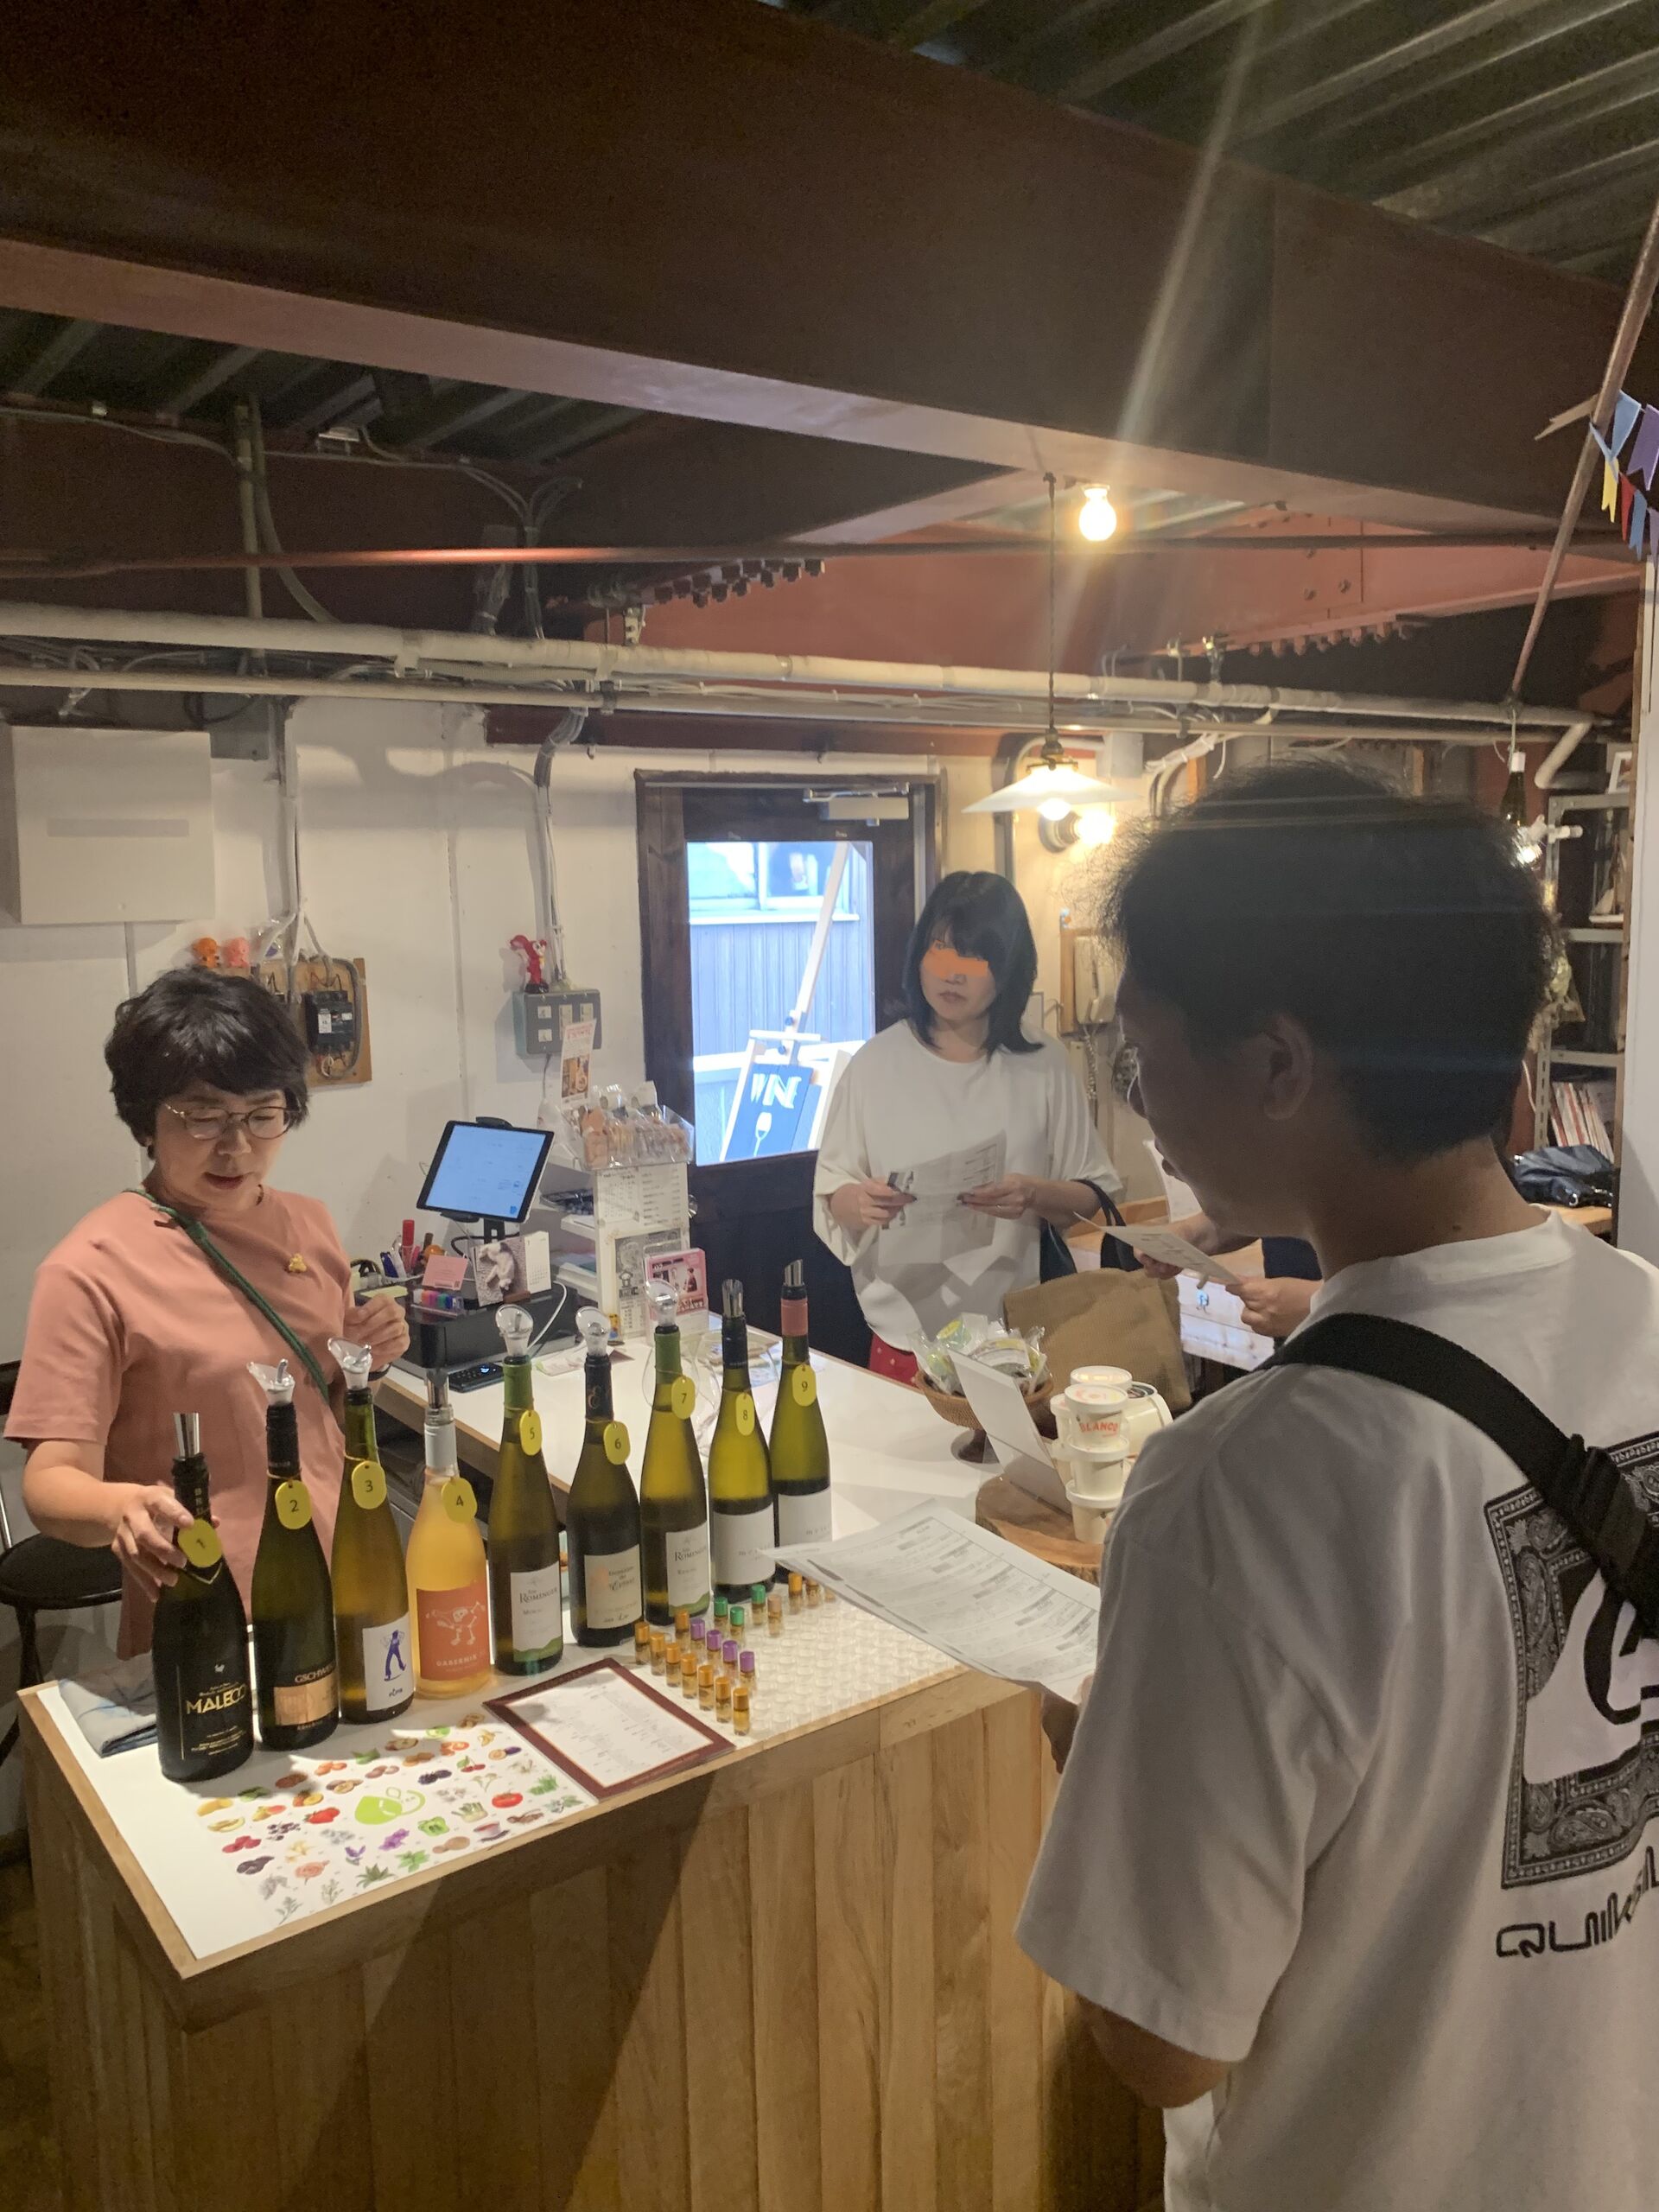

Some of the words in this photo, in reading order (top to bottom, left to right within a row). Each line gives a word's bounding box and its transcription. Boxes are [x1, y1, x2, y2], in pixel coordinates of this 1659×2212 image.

[801, 1382, 809, 1393] 9
[681, 1393, 688, 1404] 7
[742, 1409, 748, 1421] 8
[529, 1427, 536, 1440] 5
[614, 1438, 622, 1450] 6
[364, 1479, 374, 1493] 3
[289, 1498, 300, 1513] 2
[455, 1495, 464, 1507] 4
